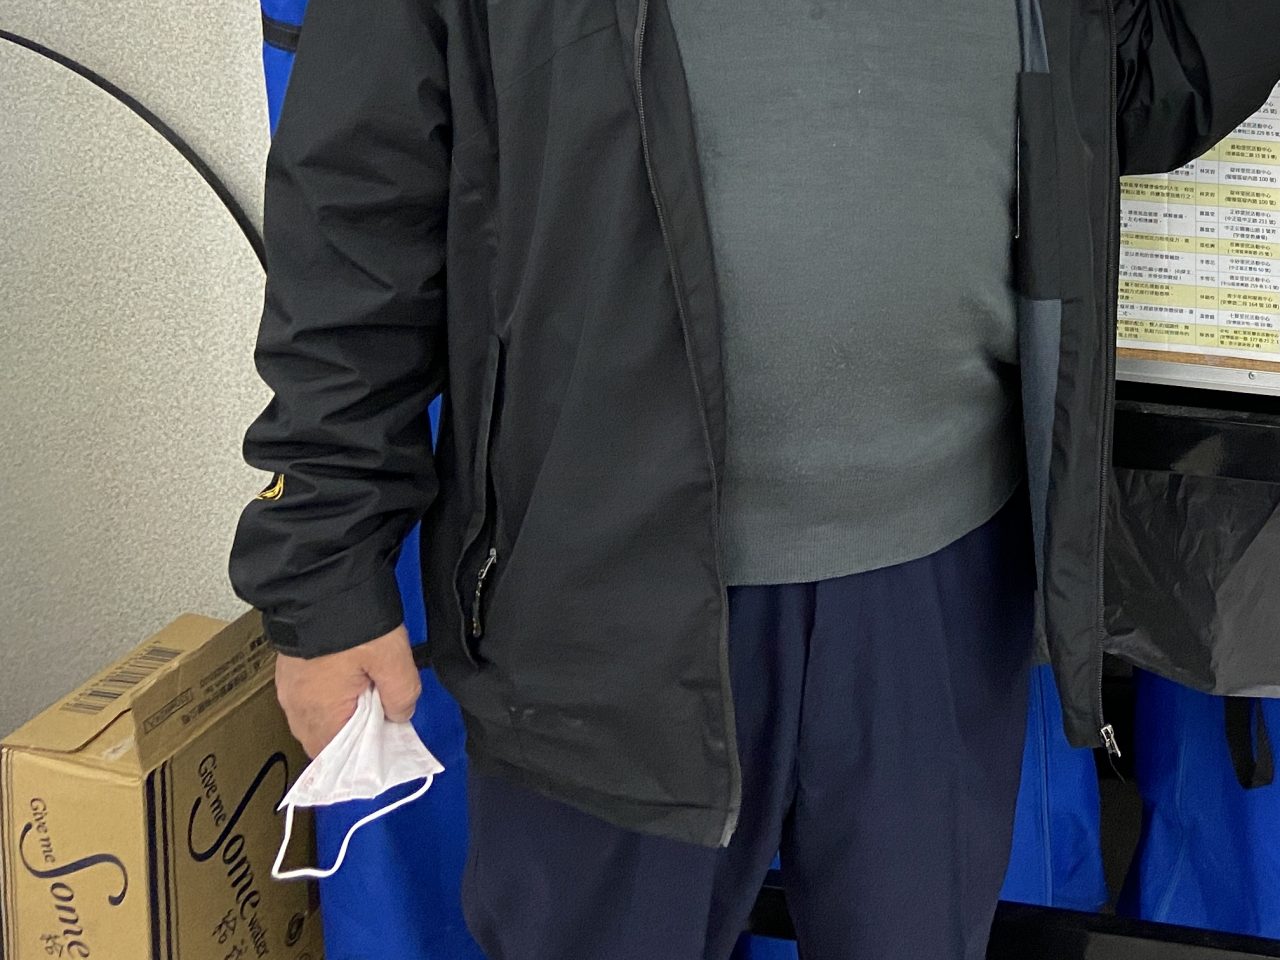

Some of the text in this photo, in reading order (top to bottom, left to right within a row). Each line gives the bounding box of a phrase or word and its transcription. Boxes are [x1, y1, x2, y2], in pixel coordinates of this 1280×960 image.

[30, 797, 55, 863] Give me
[198, 753, 227, 827] Give me
[20, 822, 128, 958] Some
[188, 751, 288, 920] Some
[248, 913, 269, 958] water
